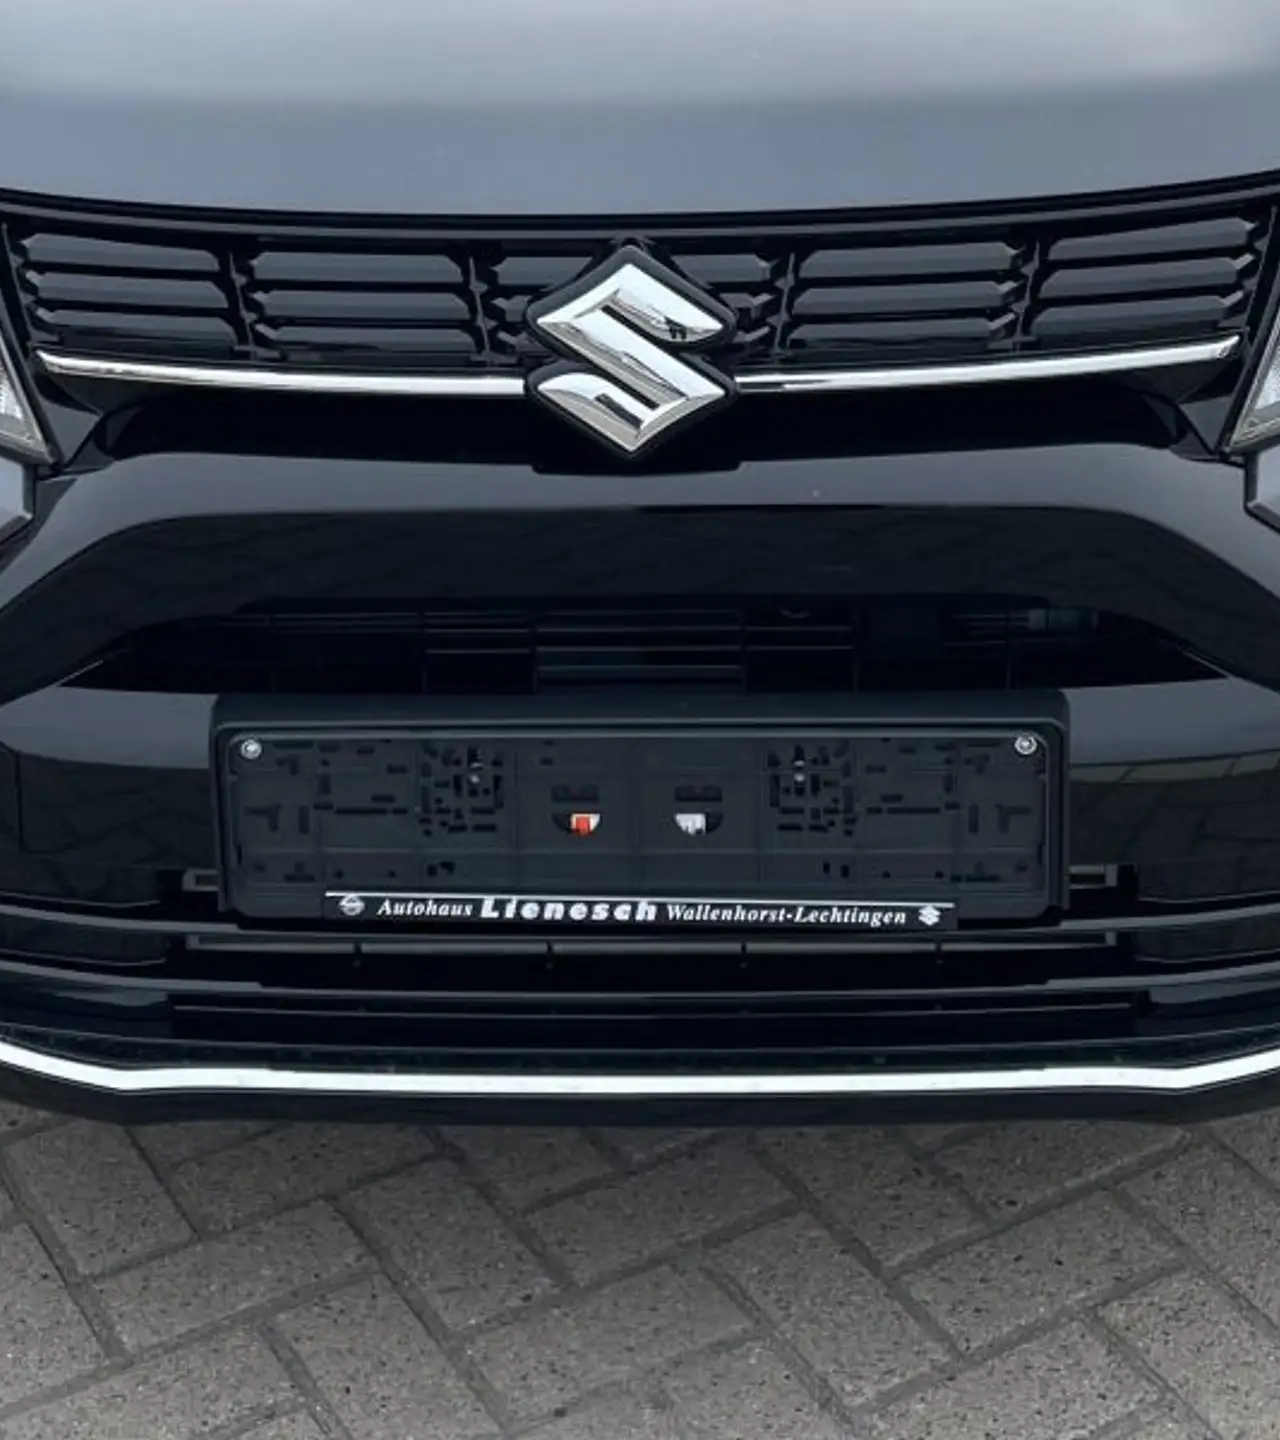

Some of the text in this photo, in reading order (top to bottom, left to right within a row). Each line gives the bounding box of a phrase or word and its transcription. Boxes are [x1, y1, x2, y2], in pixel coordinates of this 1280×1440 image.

[376, 895, 907, 927] Autohaus Lienesch Wallenhorst-Lechtingen
